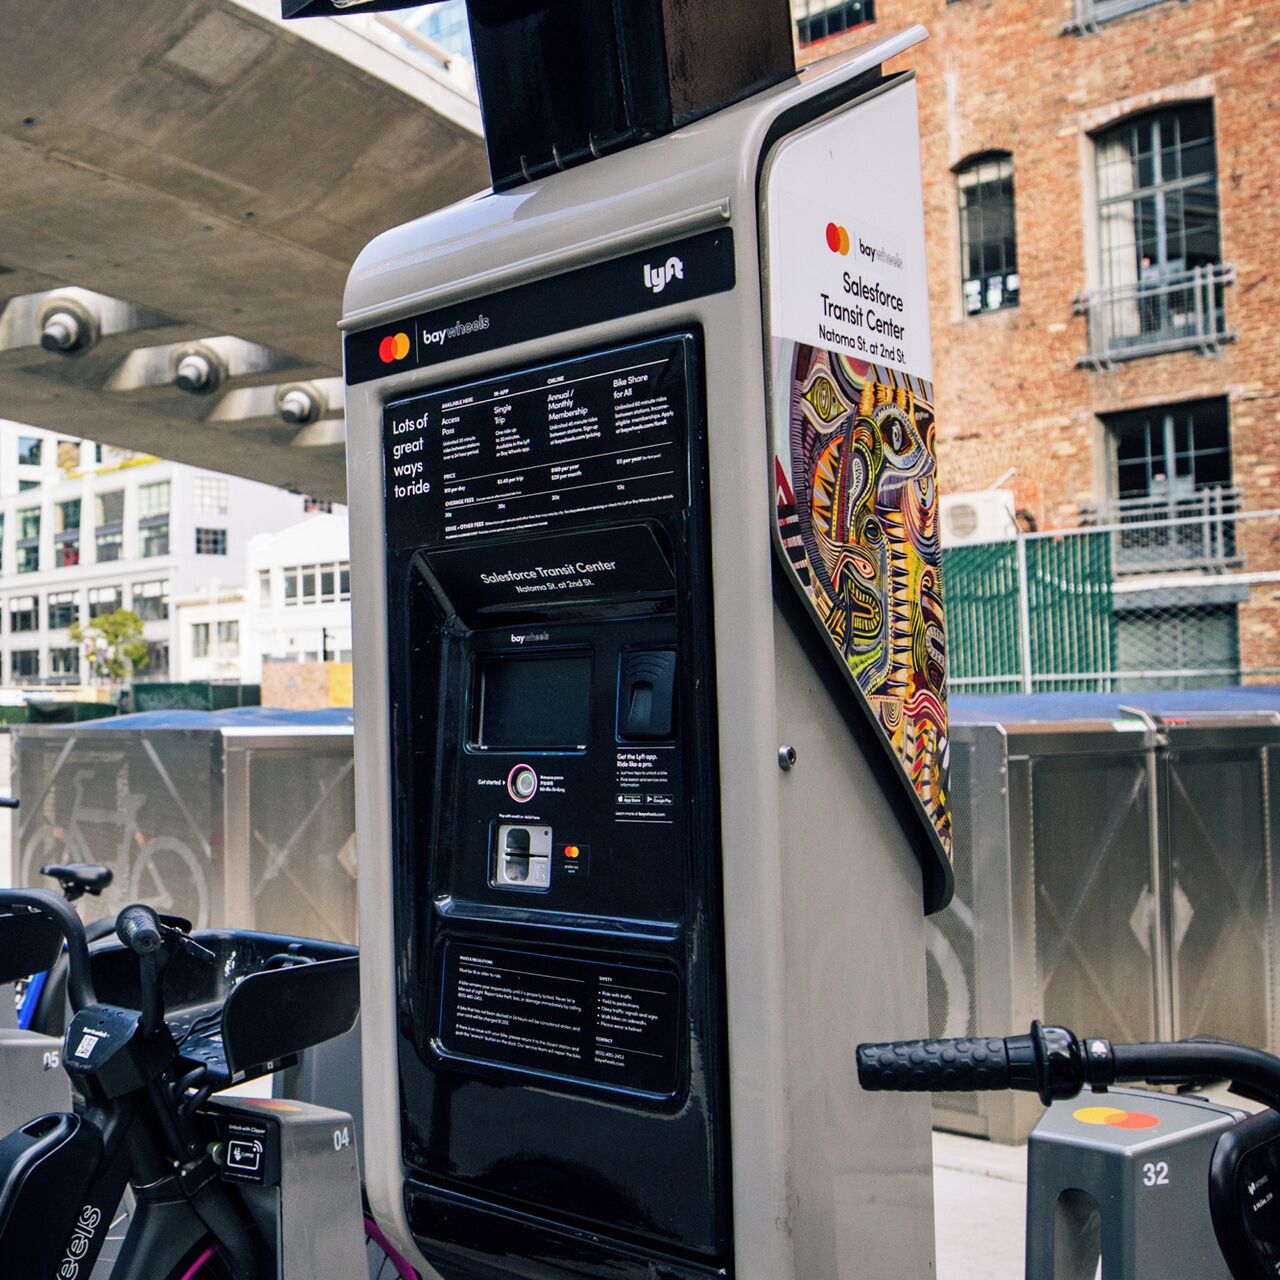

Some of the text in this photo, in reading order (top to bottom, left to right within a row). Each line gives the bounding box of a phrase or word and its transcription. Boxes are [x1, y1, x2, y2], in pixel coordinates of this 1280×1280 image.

[843, 271, 903, 312] Salesforce
[820, 293, 904, 340] Transit Center
[423, 314, 490, 345] baywheels
[819, 323, 907, 364] Natoma St. at 2nd St.
[613, 375, 648, 387] Bike Share
[548, 390, 570, 402] Annual
[613, 388, 632, 399] for All
[494, 404, 512, 414] Single
[548, 399, 574, 410] Monthly
[442, 417, 460, 425] Access
[494, 416, 505, 425] Trip
[548, 407, 588, 421] Membership
[392, 412, 428, 434] Lots of
[393, 437, 424, 459] great
[394, 461, 423, 477] ways
[394, 479, 430, 498] to ride
[480, 560, 616, 584] Salesforce Transit Center
[516, 578, 595, 594] Natoma St. at 2nd St.
[636, 753, 645, 761] Lyft
[595, 1057, 624, 1066] baywheels.com
[333, 1127, 350, 1151] 04
[1143, 1161, 1169, 1186] 32
